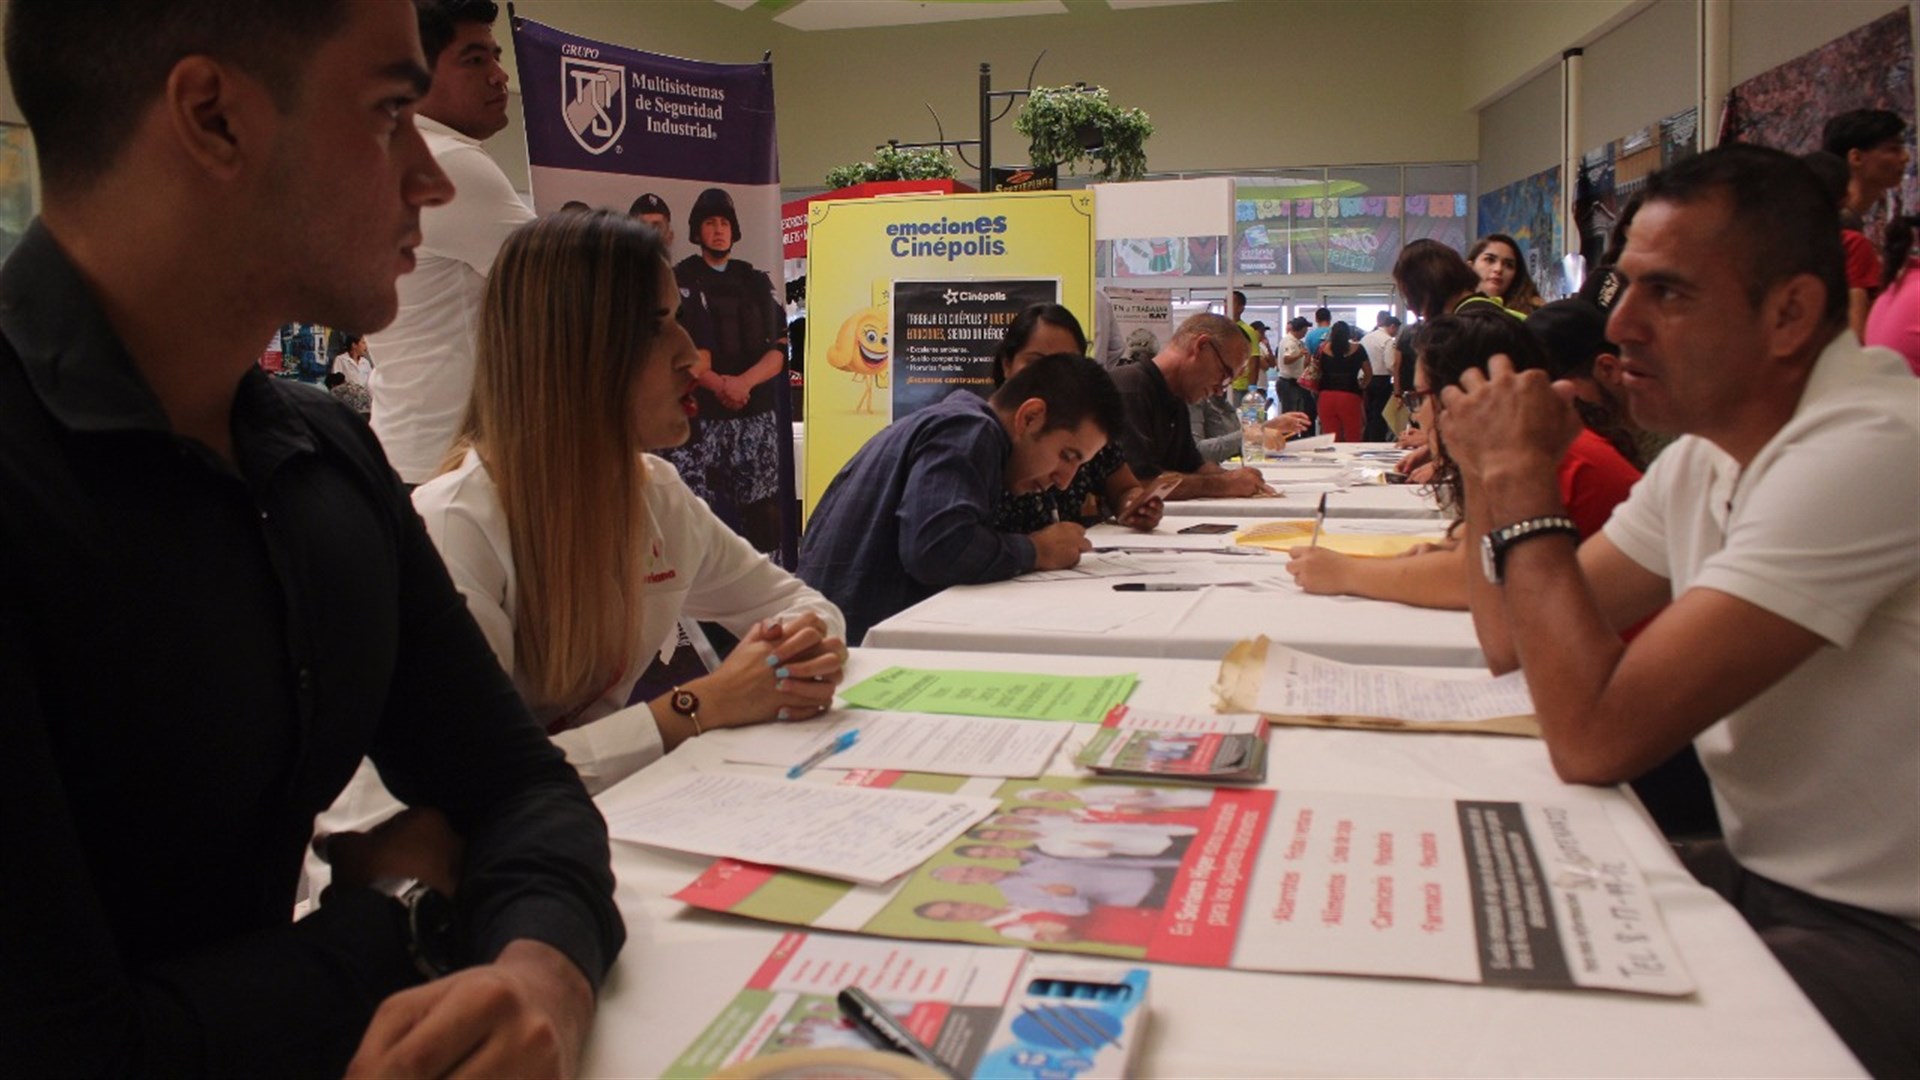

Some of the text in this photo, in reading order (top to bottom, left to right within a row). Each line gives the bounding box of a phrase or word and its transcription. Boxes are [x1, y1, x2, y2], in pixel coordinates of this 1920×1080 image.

[562, 43, 600, 60] GRUPO
[632, 72, 725, 101] Multisistemas
[635, 94, 723, 121] de Seguridad
[891, 236, 1006, 262] Cinépolis
[960, 291, 1007, 303] Cinépolis
[1174, 880, 1209, 922] Soriana
